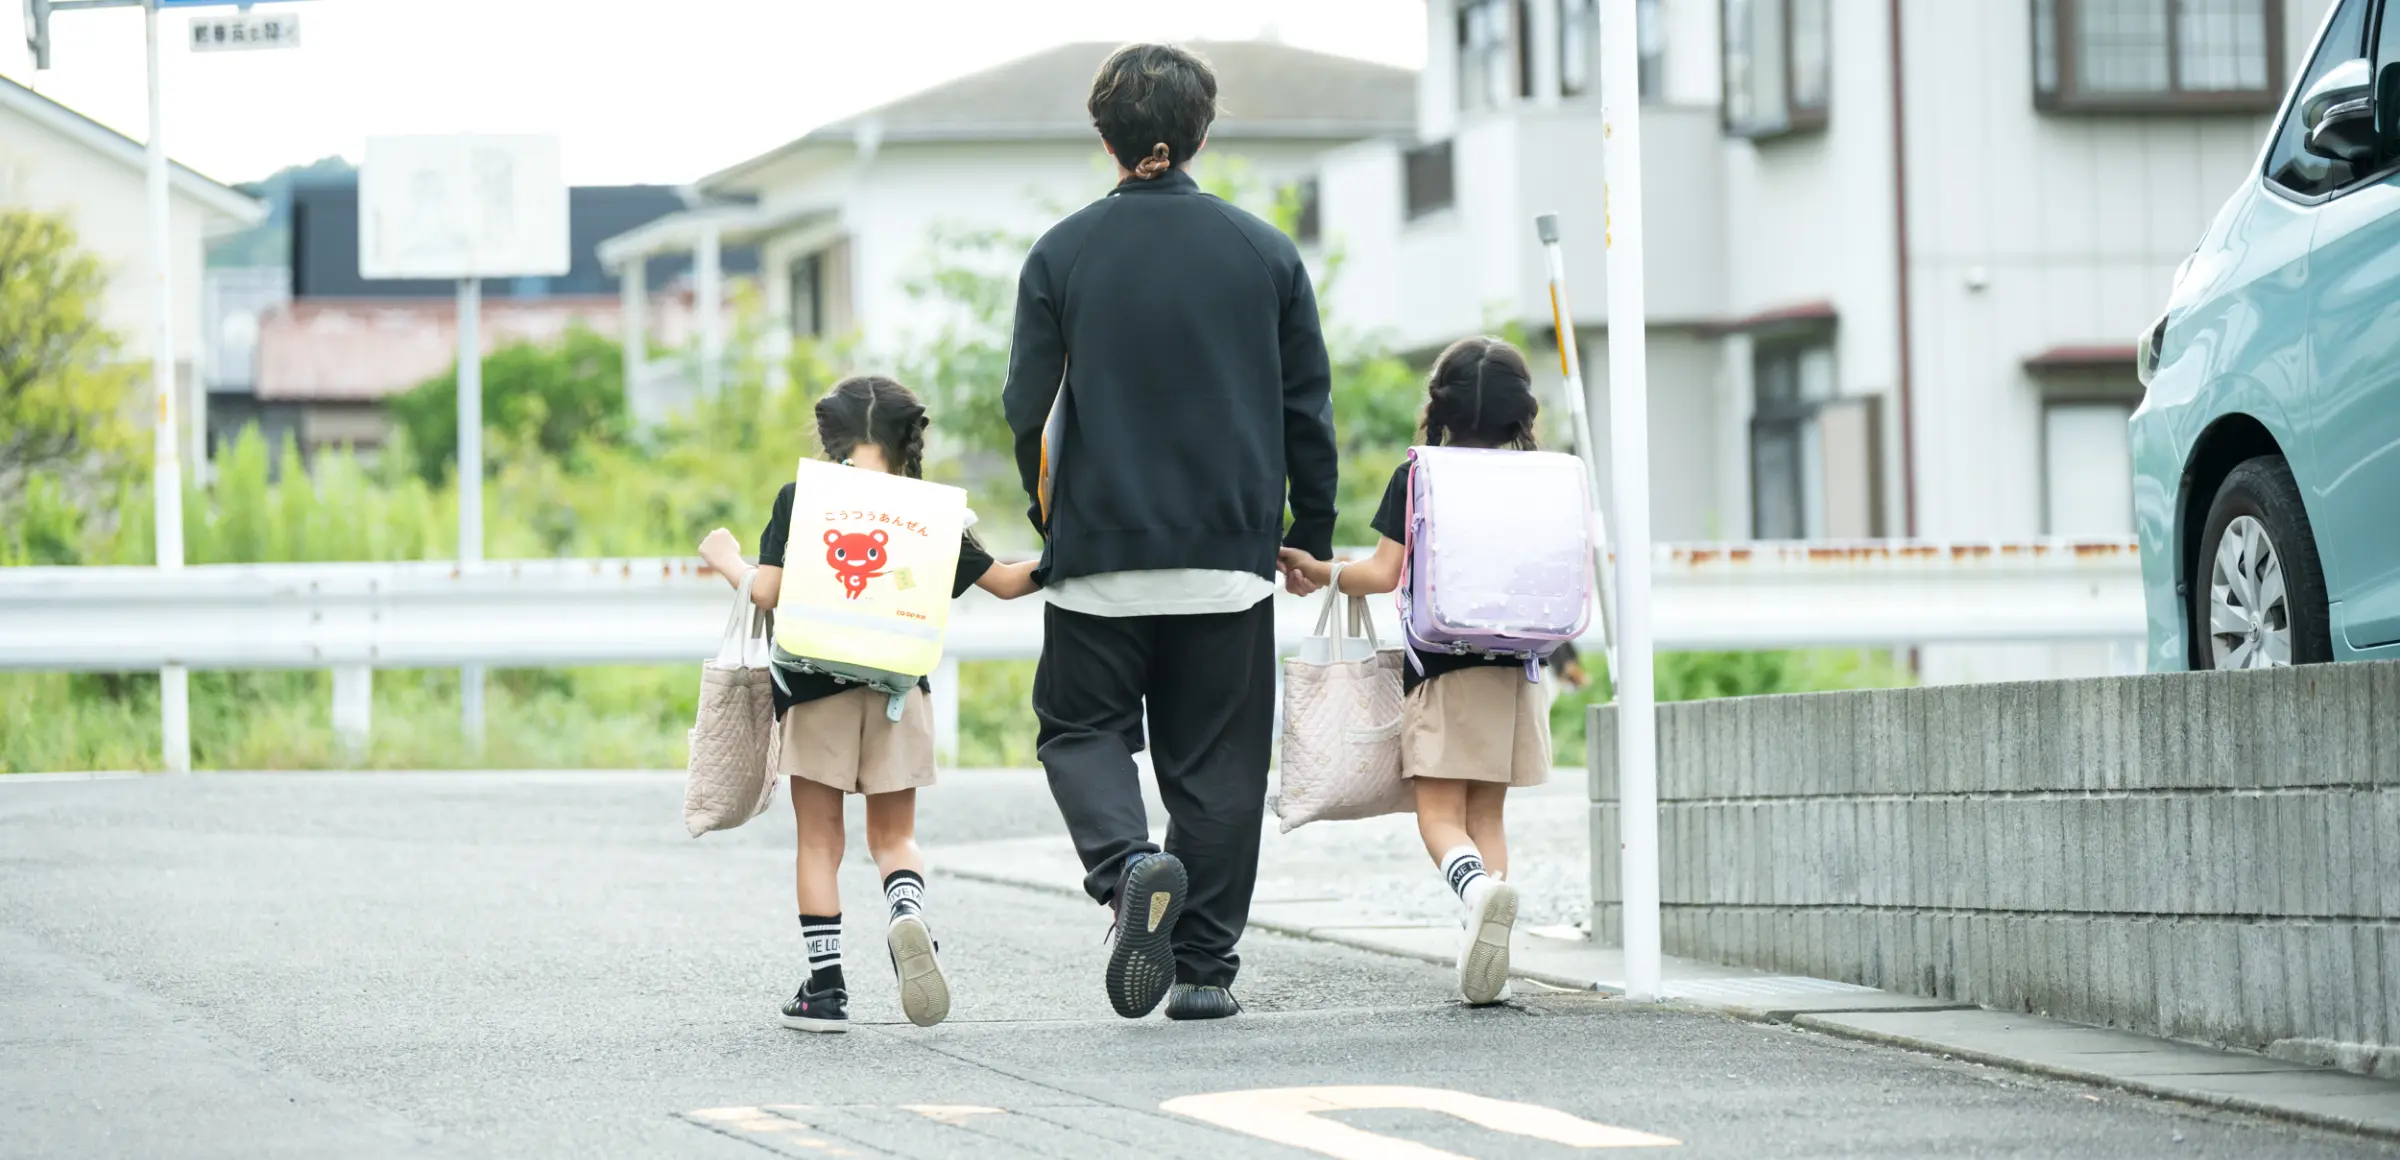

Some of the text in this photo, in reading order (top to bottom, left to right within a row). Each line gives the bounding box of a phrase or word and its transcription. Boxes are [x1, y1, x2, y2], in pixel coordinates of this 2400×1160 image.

[825, 510, 928, 537] こうつうあんぜん
[850, 575, 861, 587] C
[1453, 864, 1468, 883] ME
[807, 939, 822, 953] ME
